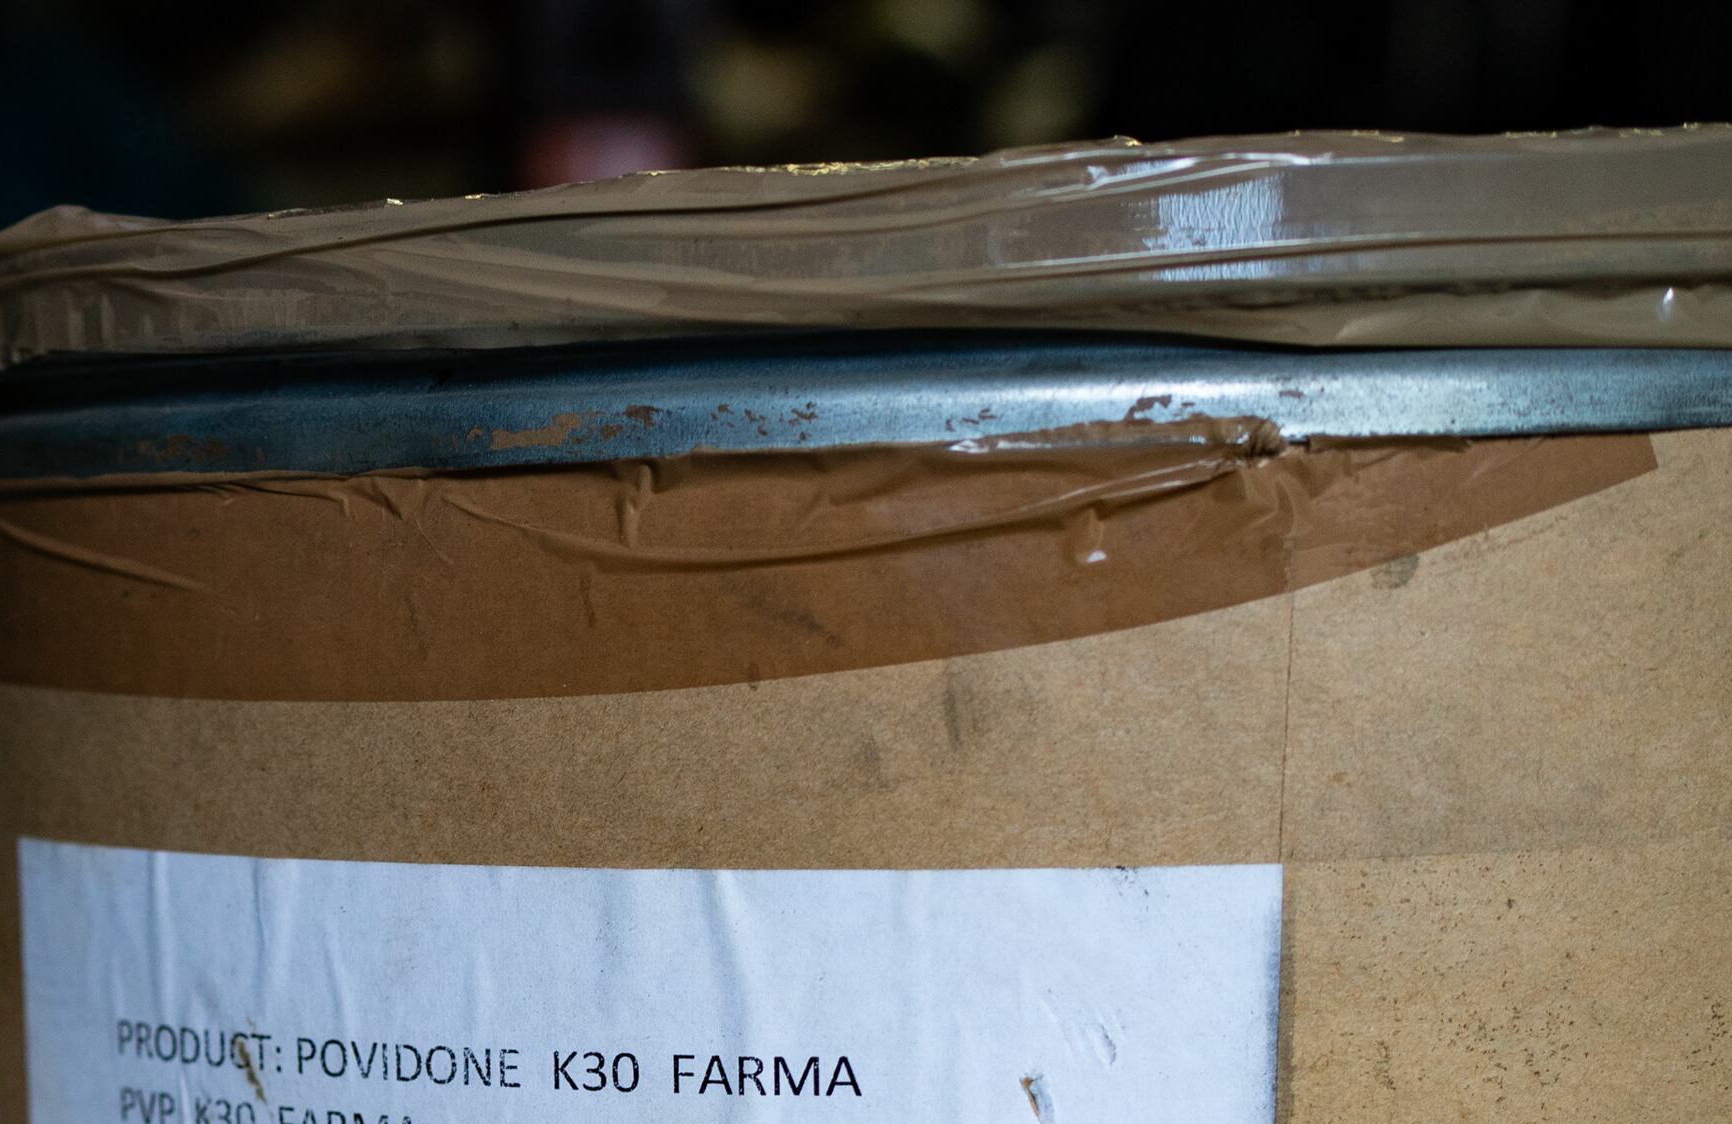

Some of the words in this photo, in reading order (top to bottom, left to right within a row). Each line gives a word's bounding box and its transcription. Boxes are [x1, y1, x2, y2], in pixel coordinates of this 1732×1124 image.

[117, 1020, 284, 1075] PRODUCT:
[296, 1038, 521, 1090] POVIDONE
[552, 1049, 641, 1094] K30
[673, 1052, 863, 1098] FARMA
